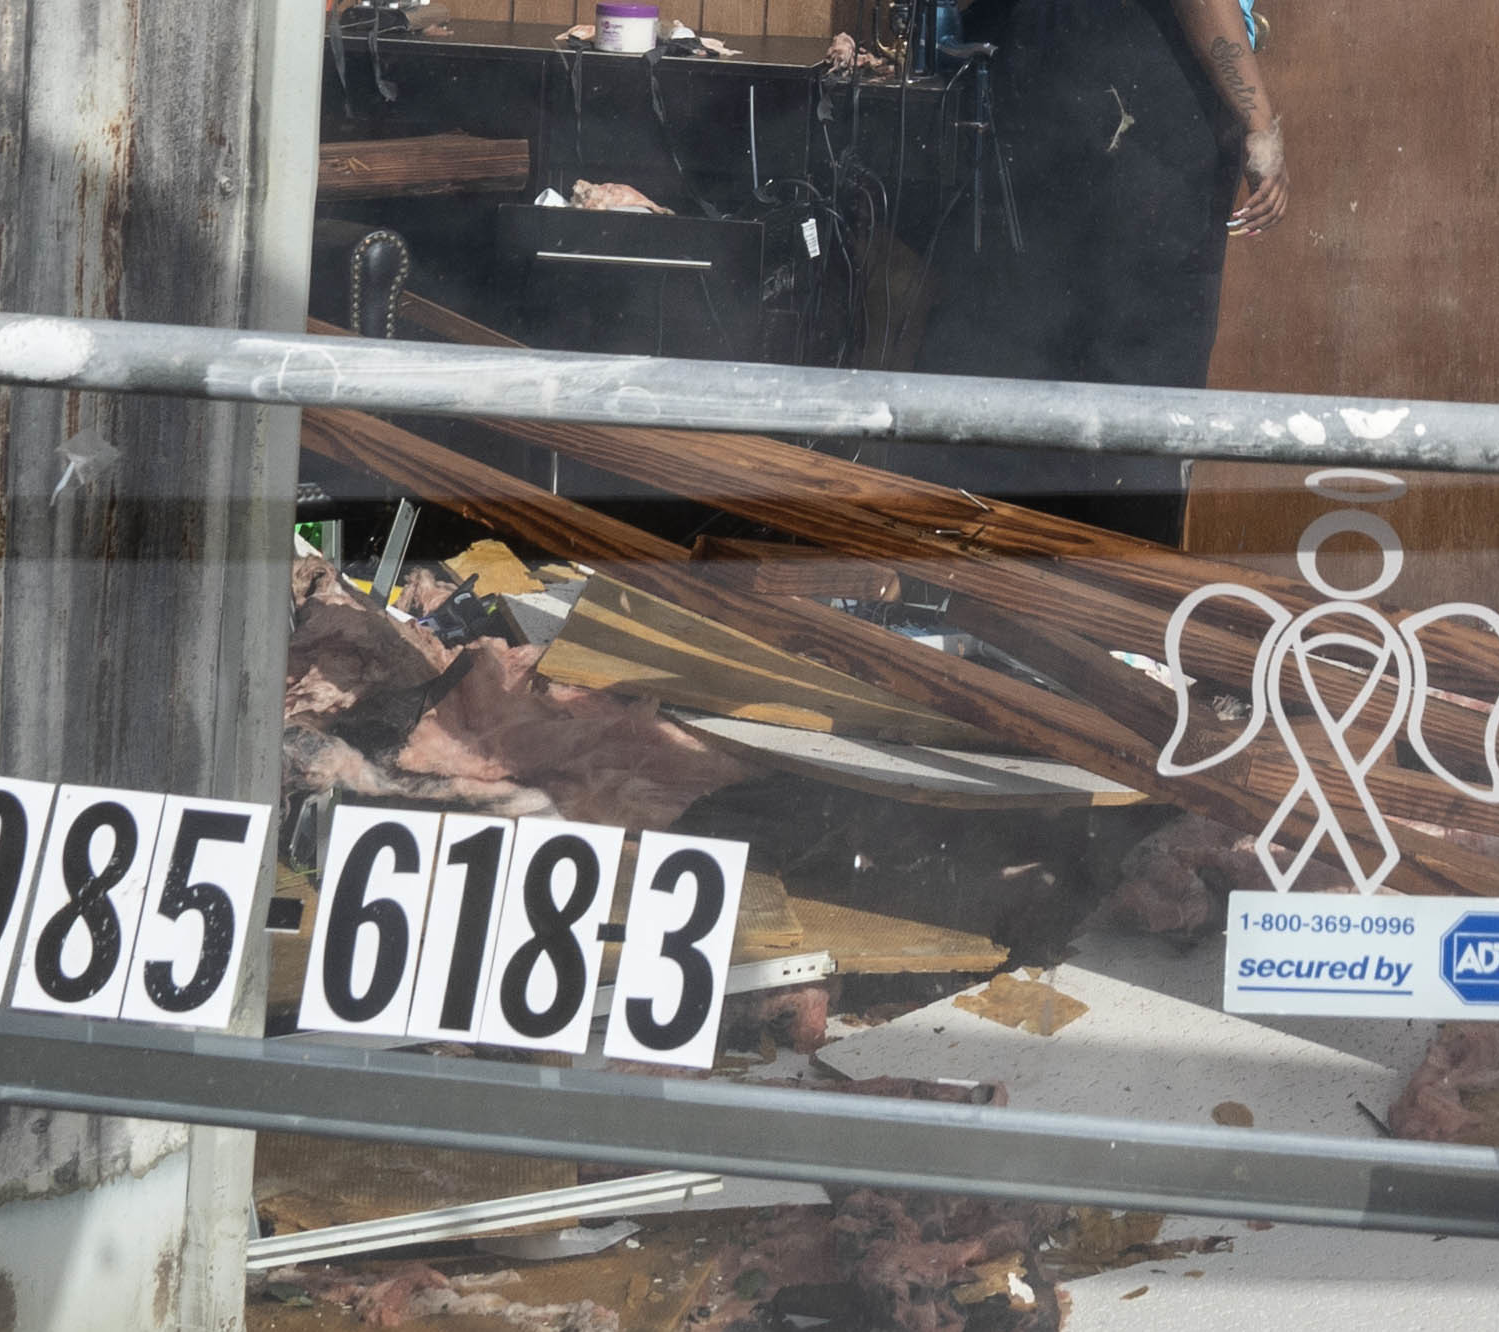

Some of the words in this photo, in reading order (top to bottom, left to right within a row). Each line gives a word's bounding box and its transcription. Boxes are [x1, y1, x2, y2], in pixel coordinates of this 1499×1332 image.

[1240, 913, 1415, 935] 1-800-369-0996
[1238, 955, 1369, 981] secured
[1374, 955, 1413, 987] by
